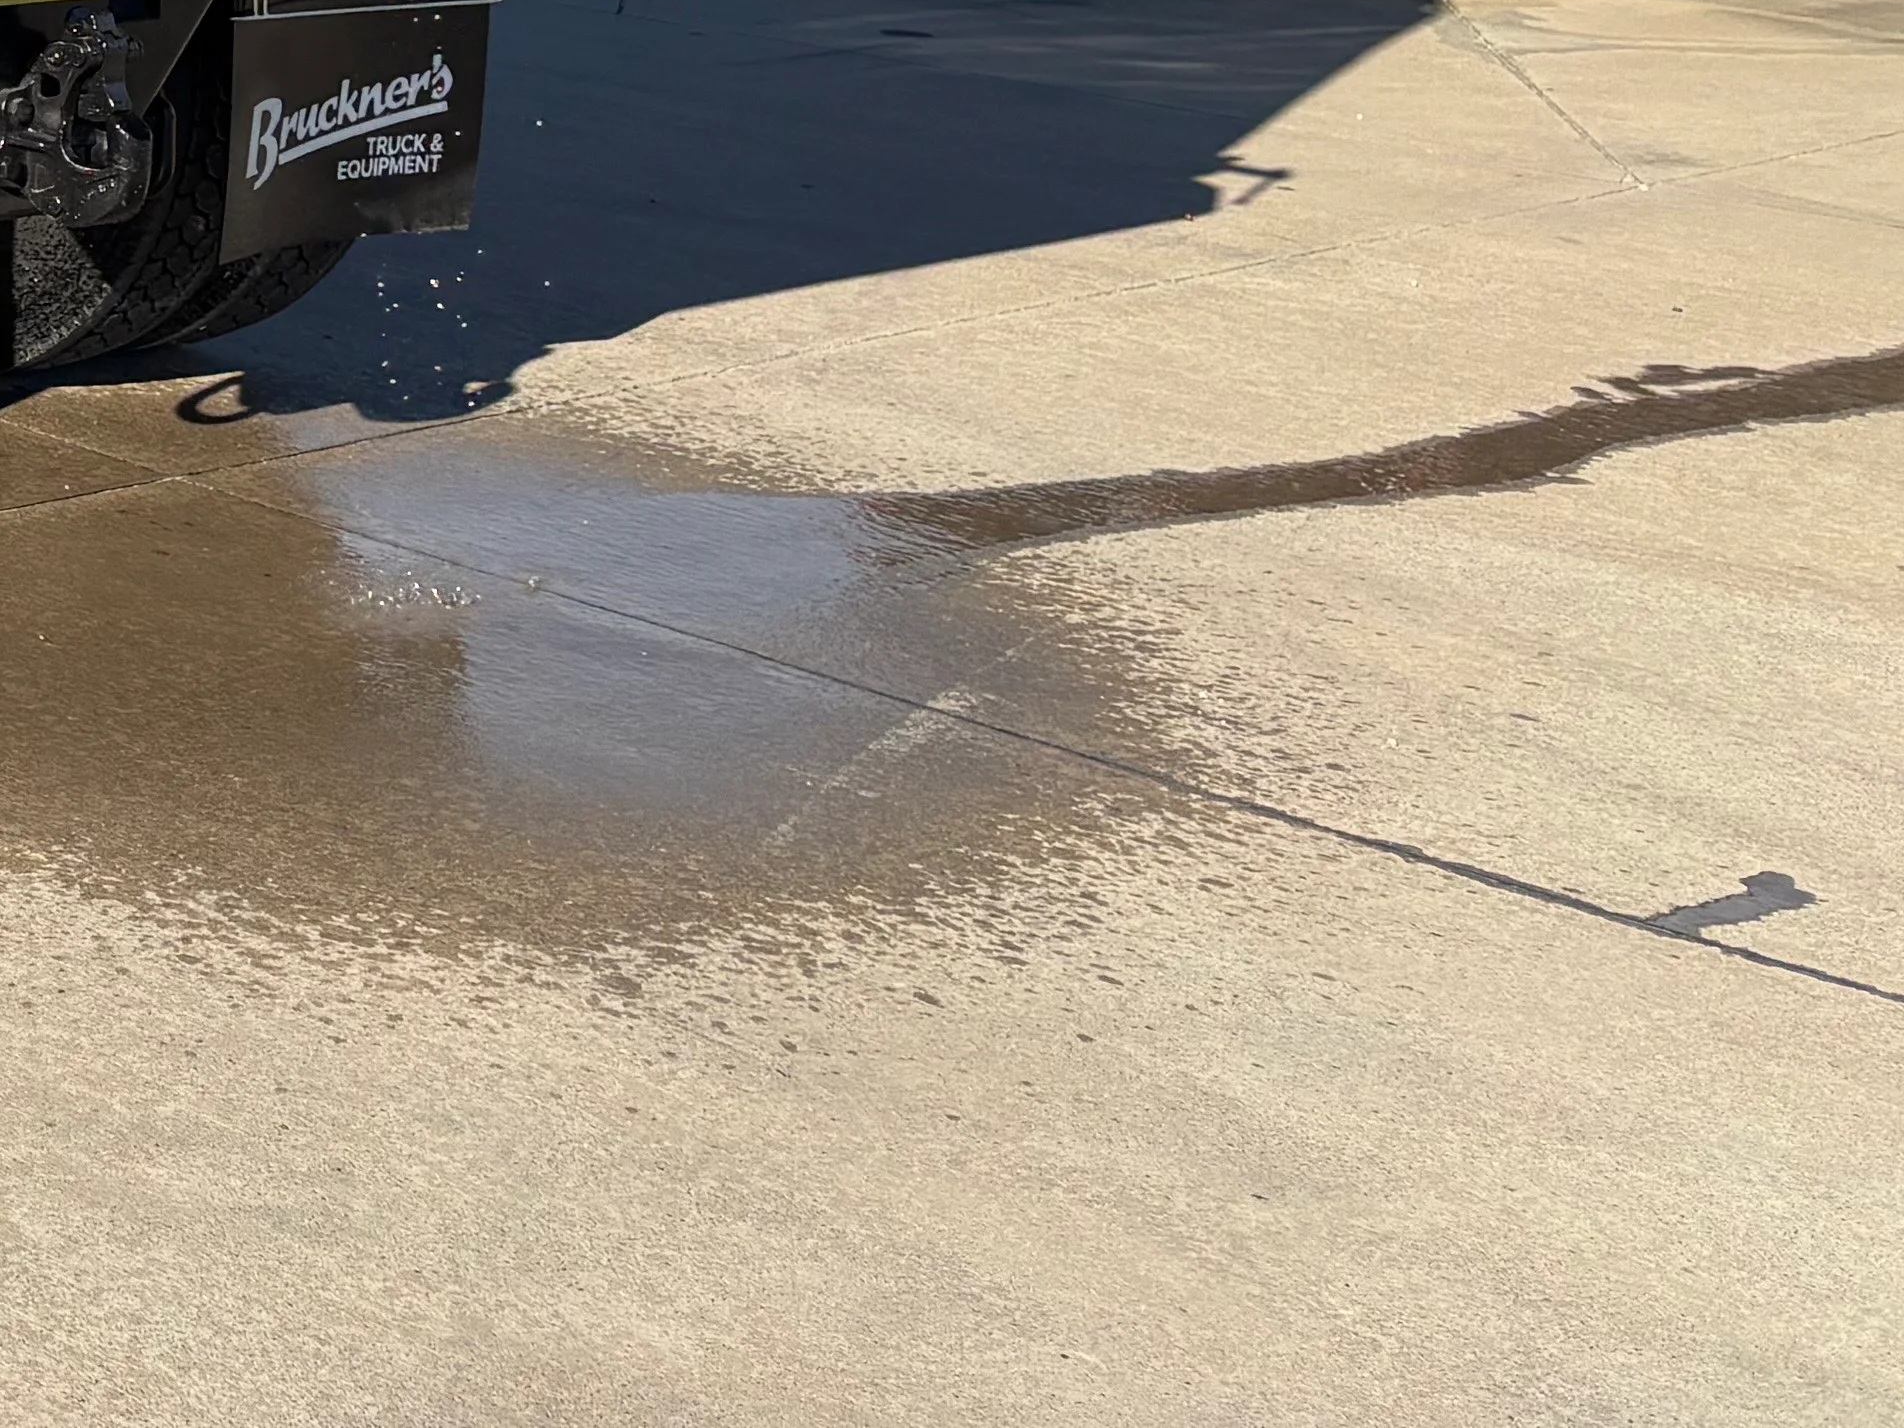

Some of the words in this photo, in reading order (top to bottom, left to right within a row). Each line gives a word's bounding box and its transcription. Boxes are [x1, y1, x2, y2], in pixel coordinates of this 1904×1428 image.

[246, 54, 454, 191] Bruckner's
[366, 133, 427, 156] TRUCK
[430, 133, 444, 152] &
[337, 154, 442, 180] EQUIPMENT
